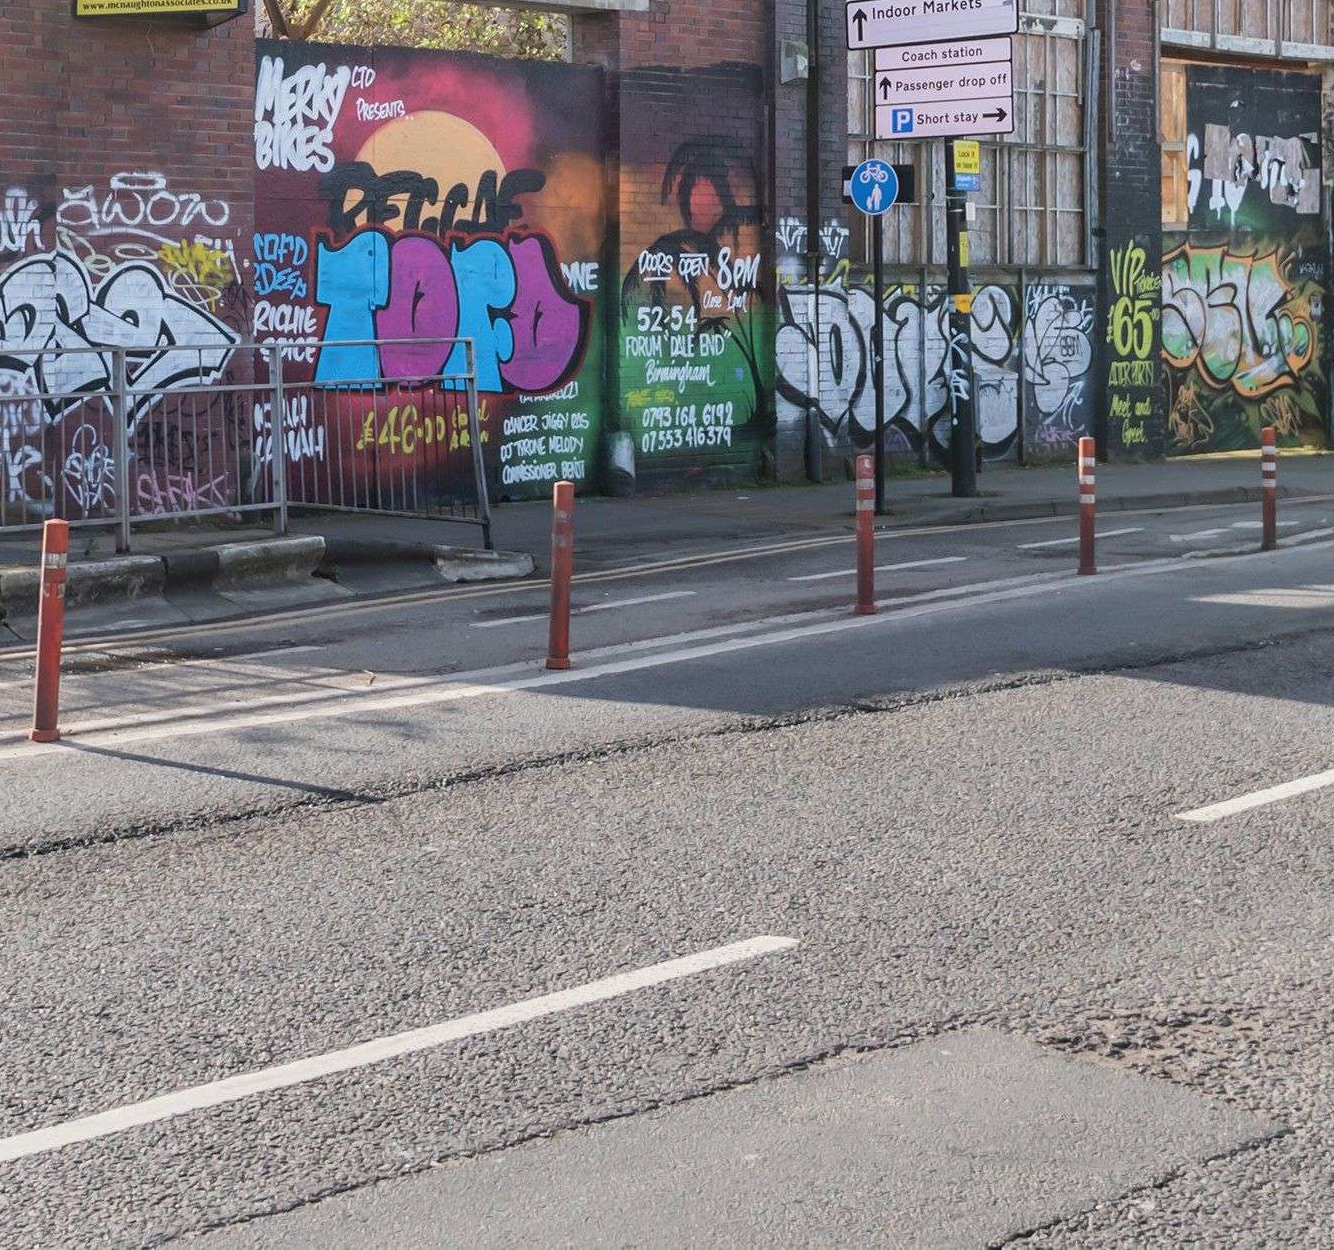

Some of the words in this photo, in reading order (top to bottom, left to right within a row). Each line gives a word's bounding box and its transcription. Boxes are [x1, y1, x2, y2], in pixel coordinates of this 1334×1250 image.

[872, 5, 917, 20] Indoor
[901, 49, 938, 62] Coach
[941, 46, 983, 59] station
[351, 66, 376, 89] LTD
[895, 79, 954, 93] Passenger
[958, 76, 986, 89] drop
[990, 73, 1008, 85] off
[896, 110, 911, 132] P
[916, 112, 950, 126] Short
[953, 112, 979, 125] stay
[253, 120, 335, 173] BIKES
[638, 249, 673, 276] DOORS
[678, 253, 710, 282] OPEN
[1110, 238, 1147, 298] VIP
[625, 335, 662, 359] FORUM
[644, 358, 717, 393] Birmingham
[549, 435, 584, 454] MELODY
